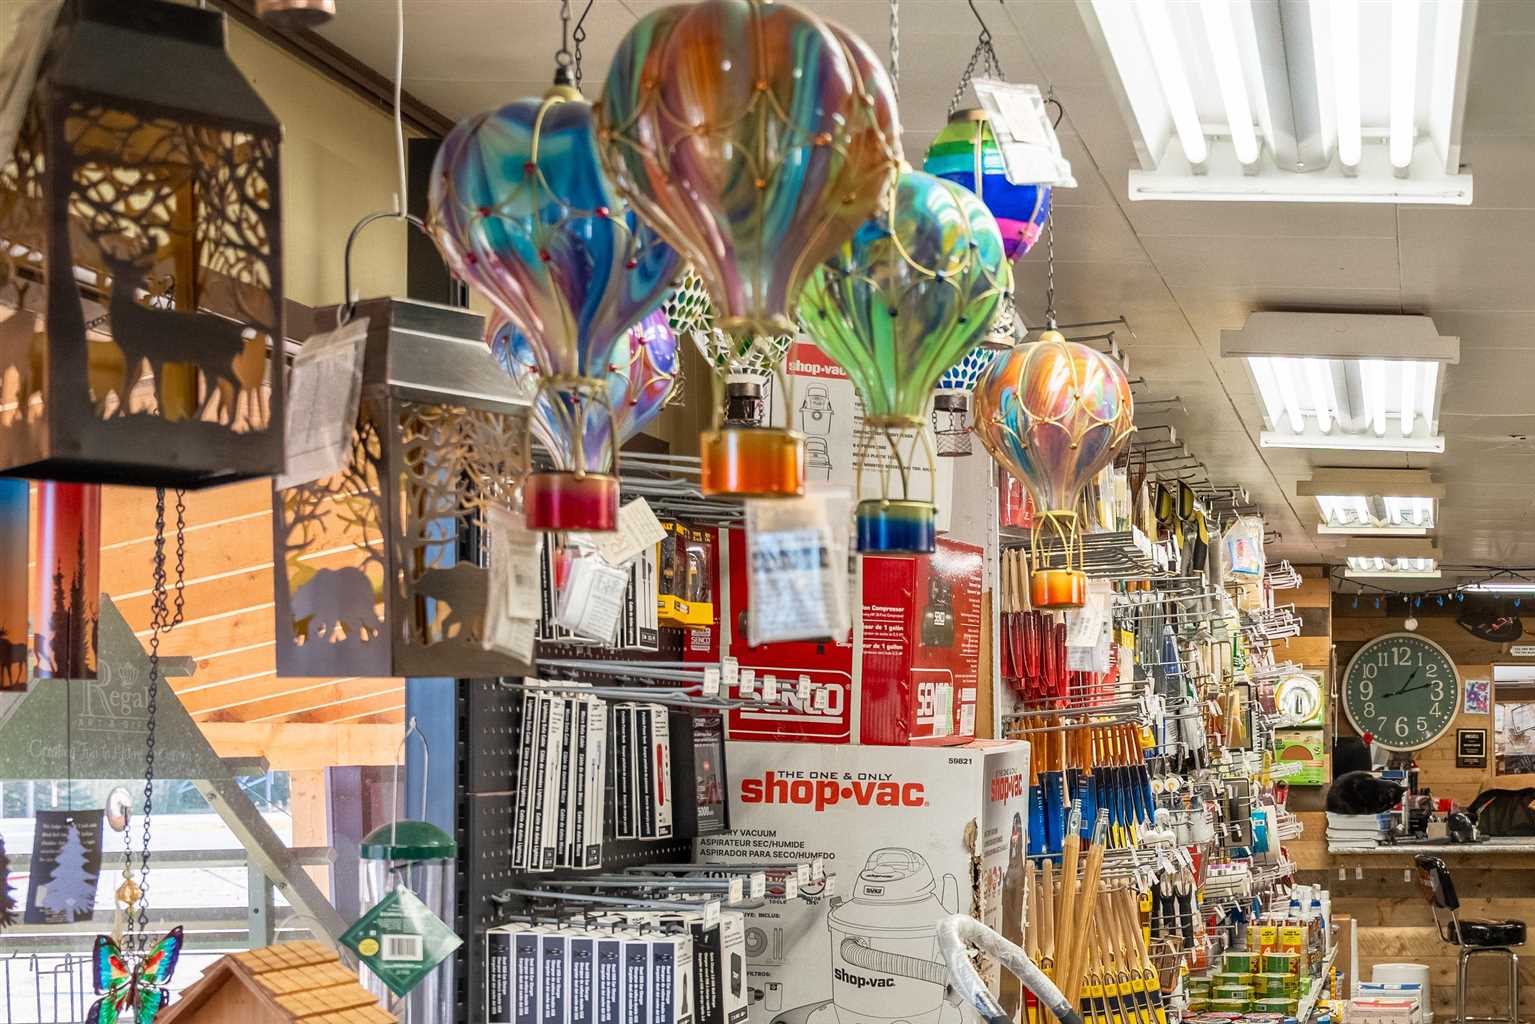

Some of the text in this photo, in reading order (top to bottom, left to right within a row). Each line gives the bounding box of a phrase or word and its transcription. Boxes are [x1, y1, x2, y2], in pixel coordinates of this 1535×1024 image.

[1378, 653, 1389, 667] 11
[1392, 647, 1411, 665] 12
[1418, 653, 1423, 666] 1
[1363, 663, 1377, 679] 10
[1426, 665, 1438, 677] 2
[1360, 680, 1374, 701] 9
[1431, 680, 1444, 701] 3
[1364, 703, 1375, 718] 8
[1429, 703, 1441, 718] 4
[1377, 717, 1387, 731] 7
[1395, 717, 1408, 737] 6
[1417, 717, 1427, 731] 5
[778, 771, 892, 782] THE ONE & ONLY
[740, 830, 777, 838] VACUUM
[700, 838, 805, 849] ASPIRATEUR SEC/HUMIDE
[700, 848, 746, 857] ASPIRADOR
[748, 850, 772, 858] PARA
